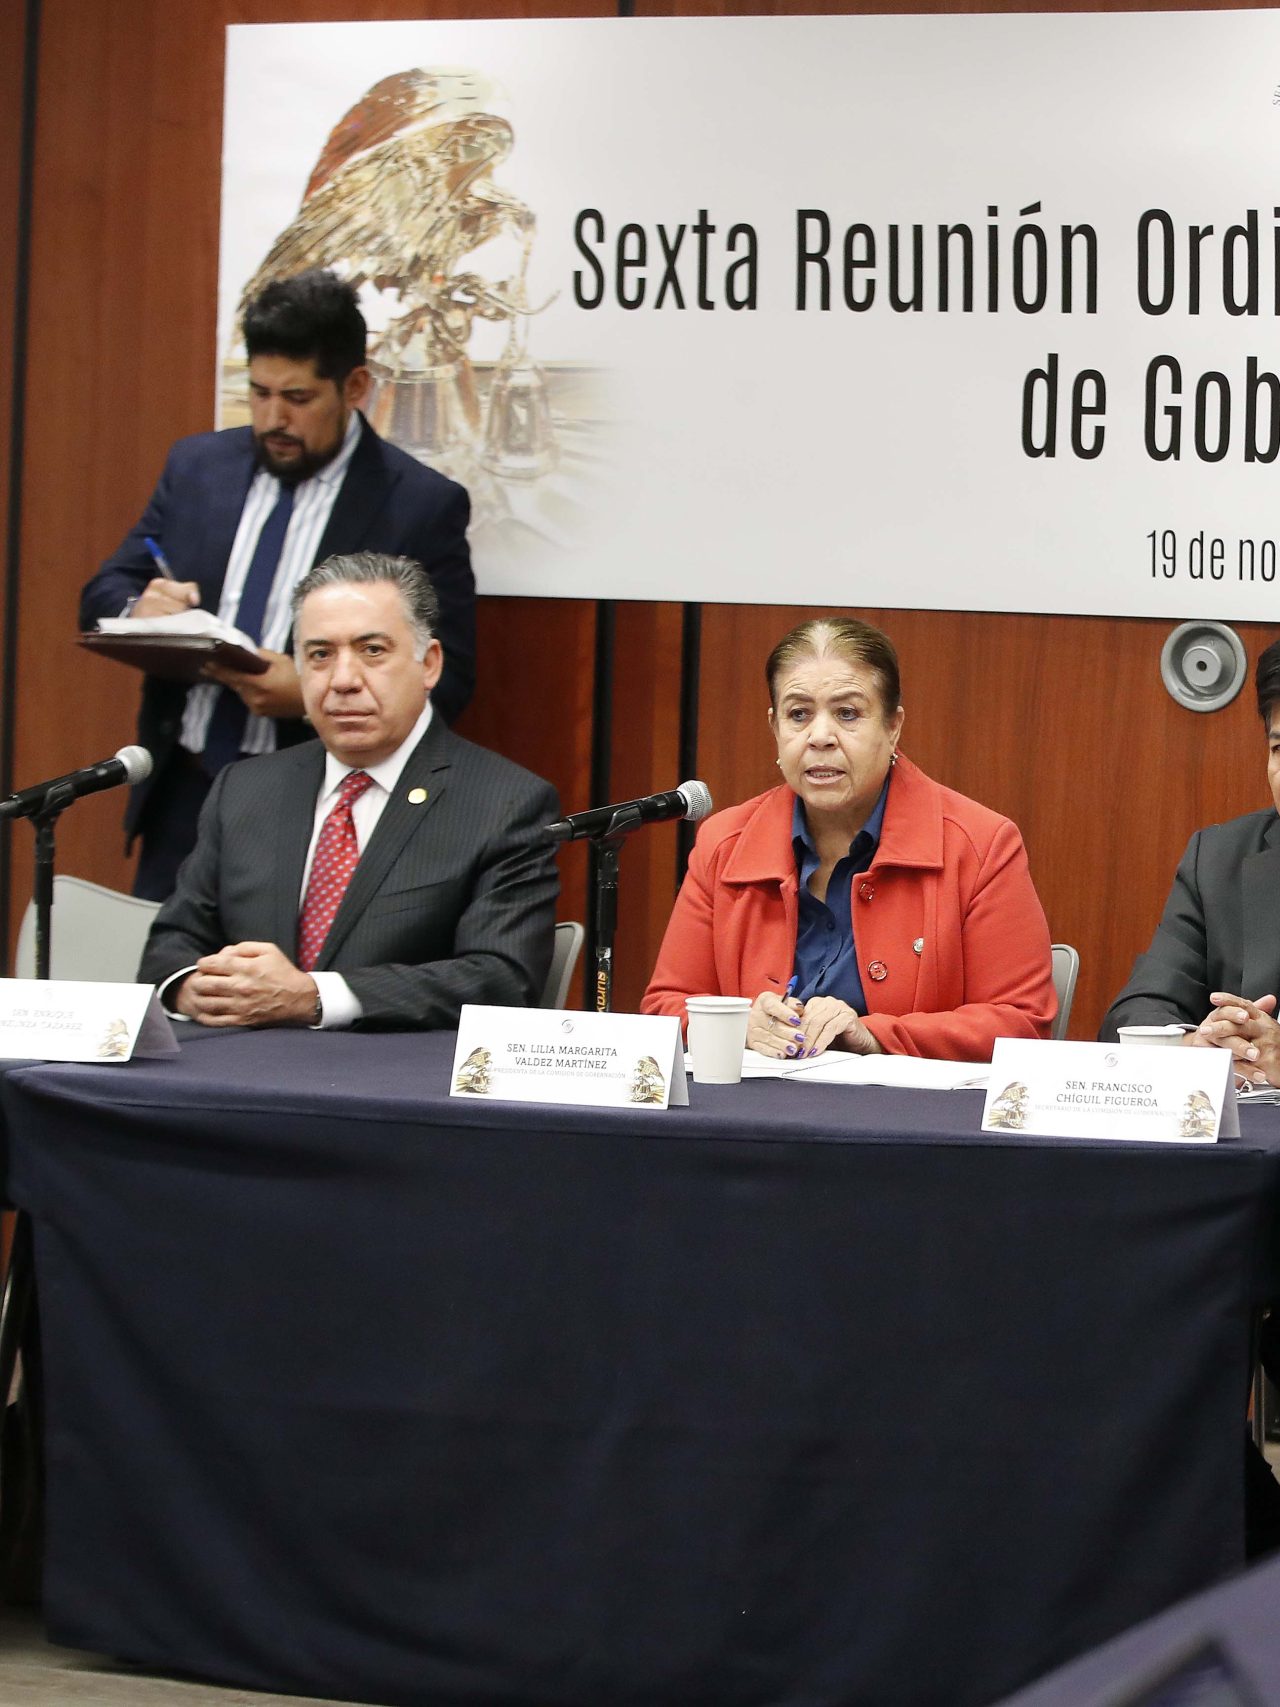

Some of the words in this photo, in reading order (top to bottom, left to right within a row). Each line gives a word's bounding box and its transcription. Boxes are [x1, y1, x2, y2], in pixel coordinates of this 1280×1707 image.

[574, 209, 758, 310] Sexta
[797, 201, 1098, 314] Reunión
[1022, 353, 1107, 459] de
[1147, 530, 1177, 578] 19
[1189, 531, 1225, 580] de
[507, 1043, 527, 1053] SEN.
[531, 1044, 555, 1054] LILIA
[558, 1046, 617, 1057] MARGARITA
[515, 1057, 553, 1067] VALDEZ
[555, 1058, 608, 1070] MARTÍNEZ
[1065, 1080, 1087, 1091] SEN.
[1091, 1082, 1153, 1094] FRANCISCO
[1056, 1093, 1101, 1105] CHÍGUIL
[1104, 1096, 1158, 1107] FIGUEROA
